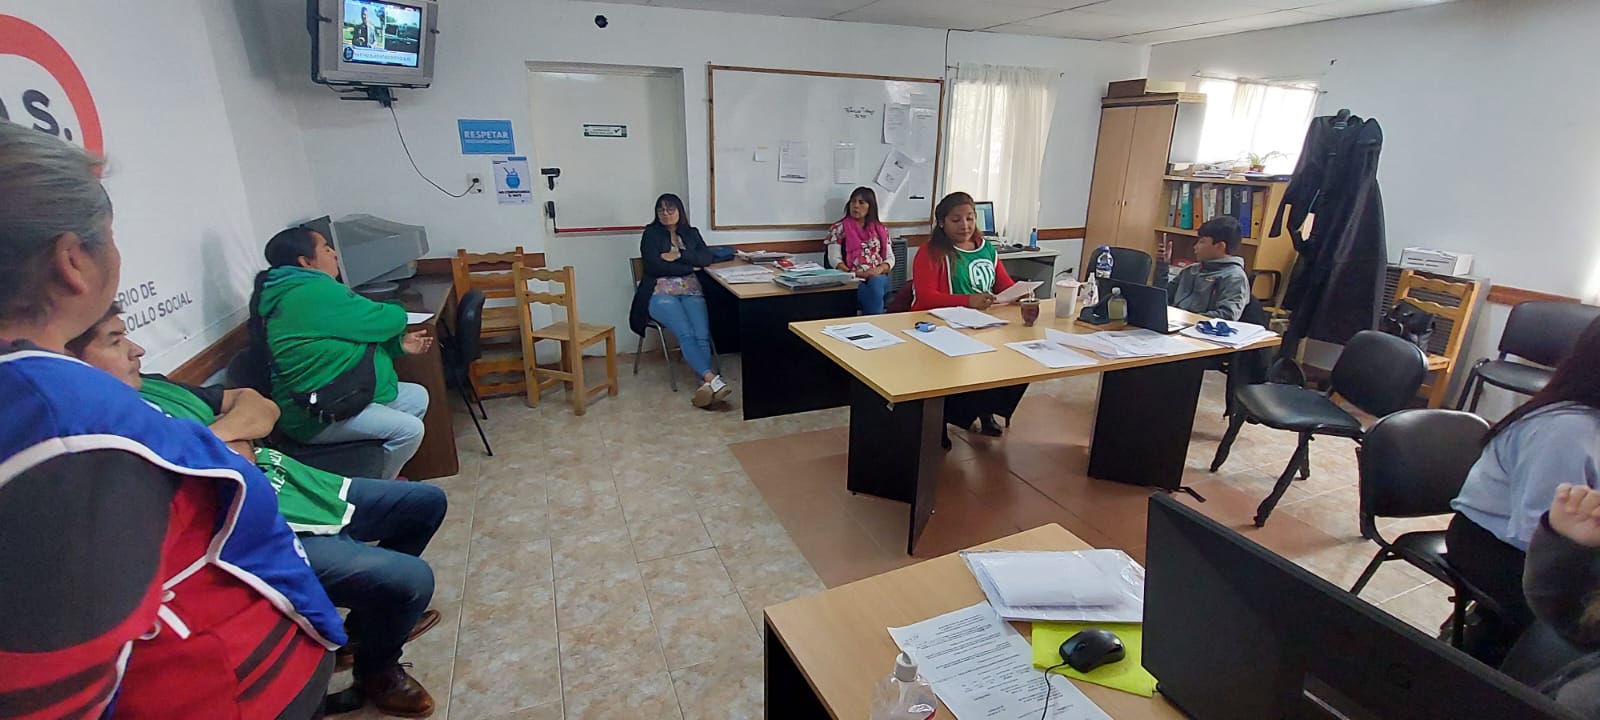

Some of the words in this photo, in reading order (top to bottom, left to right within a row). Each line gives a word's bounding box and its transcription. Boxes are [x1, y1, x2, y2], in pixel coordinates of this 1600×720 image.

[463, 130, 509, 139] RESPETAR
[140, 281, 157, 299] DE
[126, 306, 156, 333] OLLO
[157, 291, 192, 317] SOCIAL
